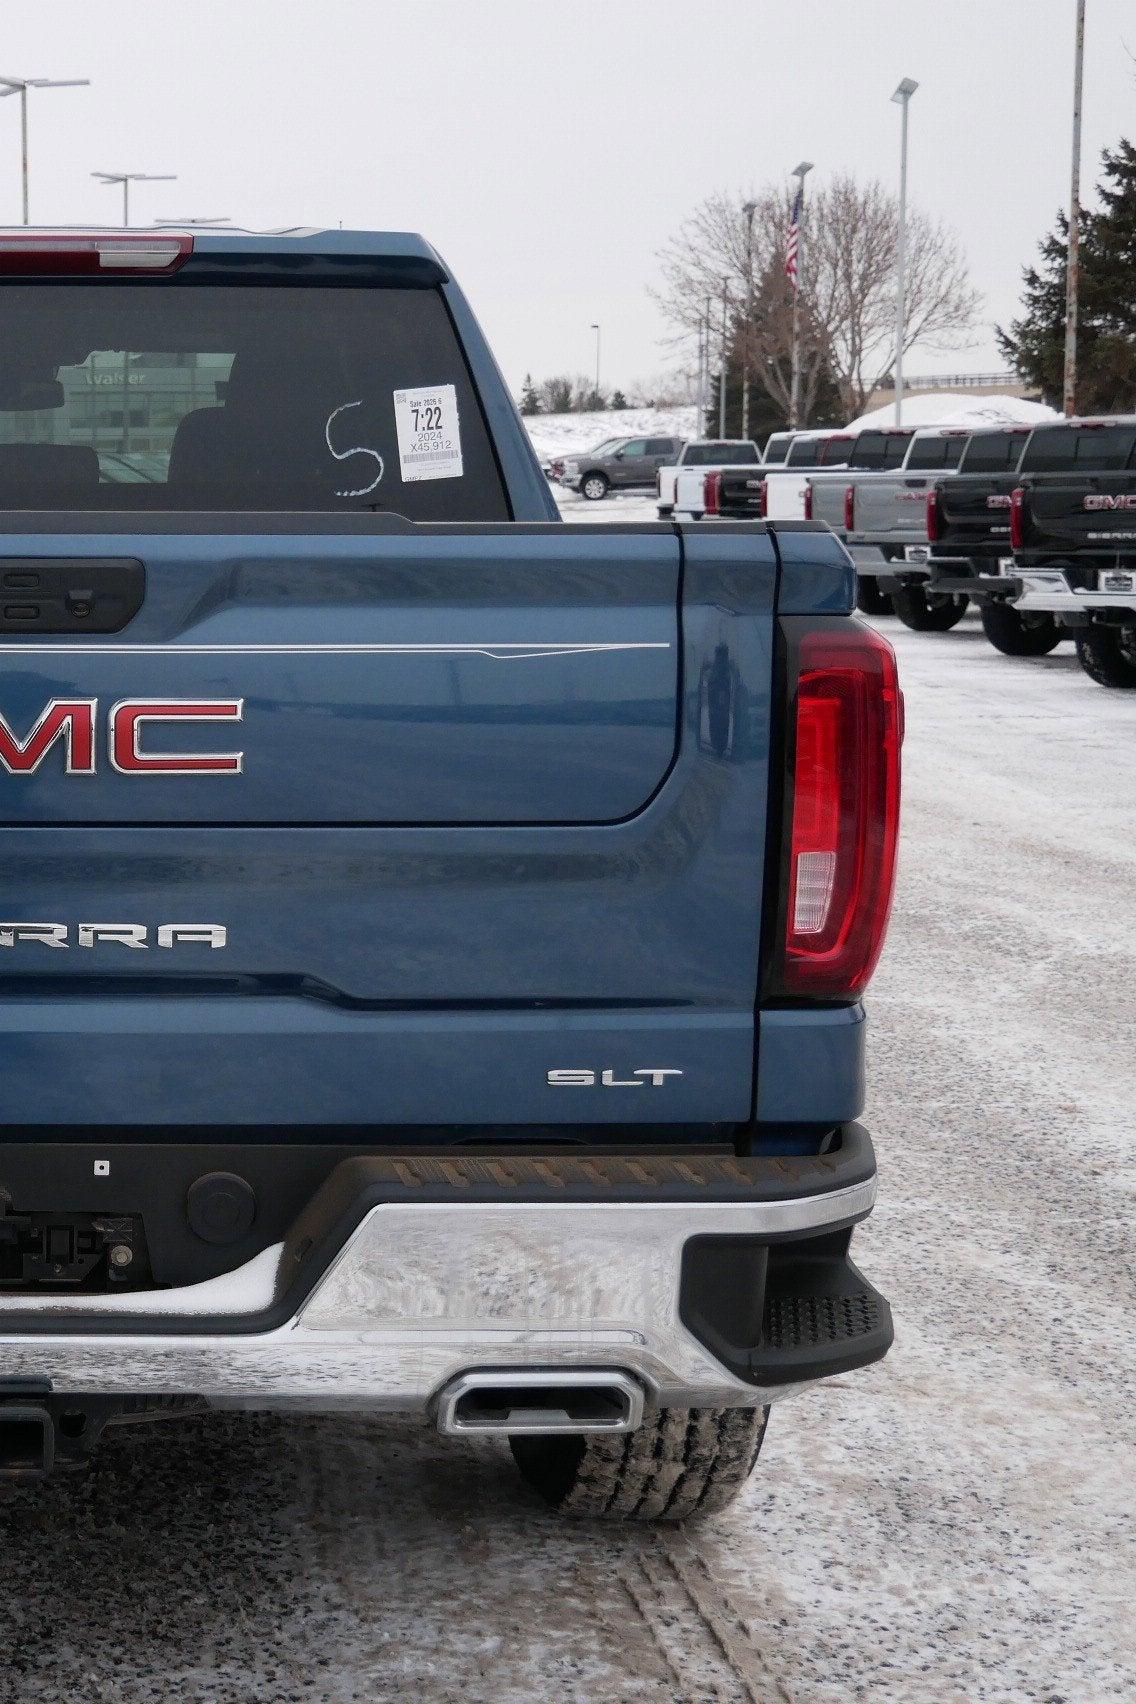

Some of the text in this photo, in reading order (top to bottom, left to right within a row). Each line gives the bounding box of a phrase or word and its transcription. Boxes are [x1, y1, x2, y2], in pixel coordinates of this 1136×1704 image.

[411, 406, 443, 432] 7:22
[417, 431, 443, 442] 2024
[547, 1069, 683, 1086] SLT
